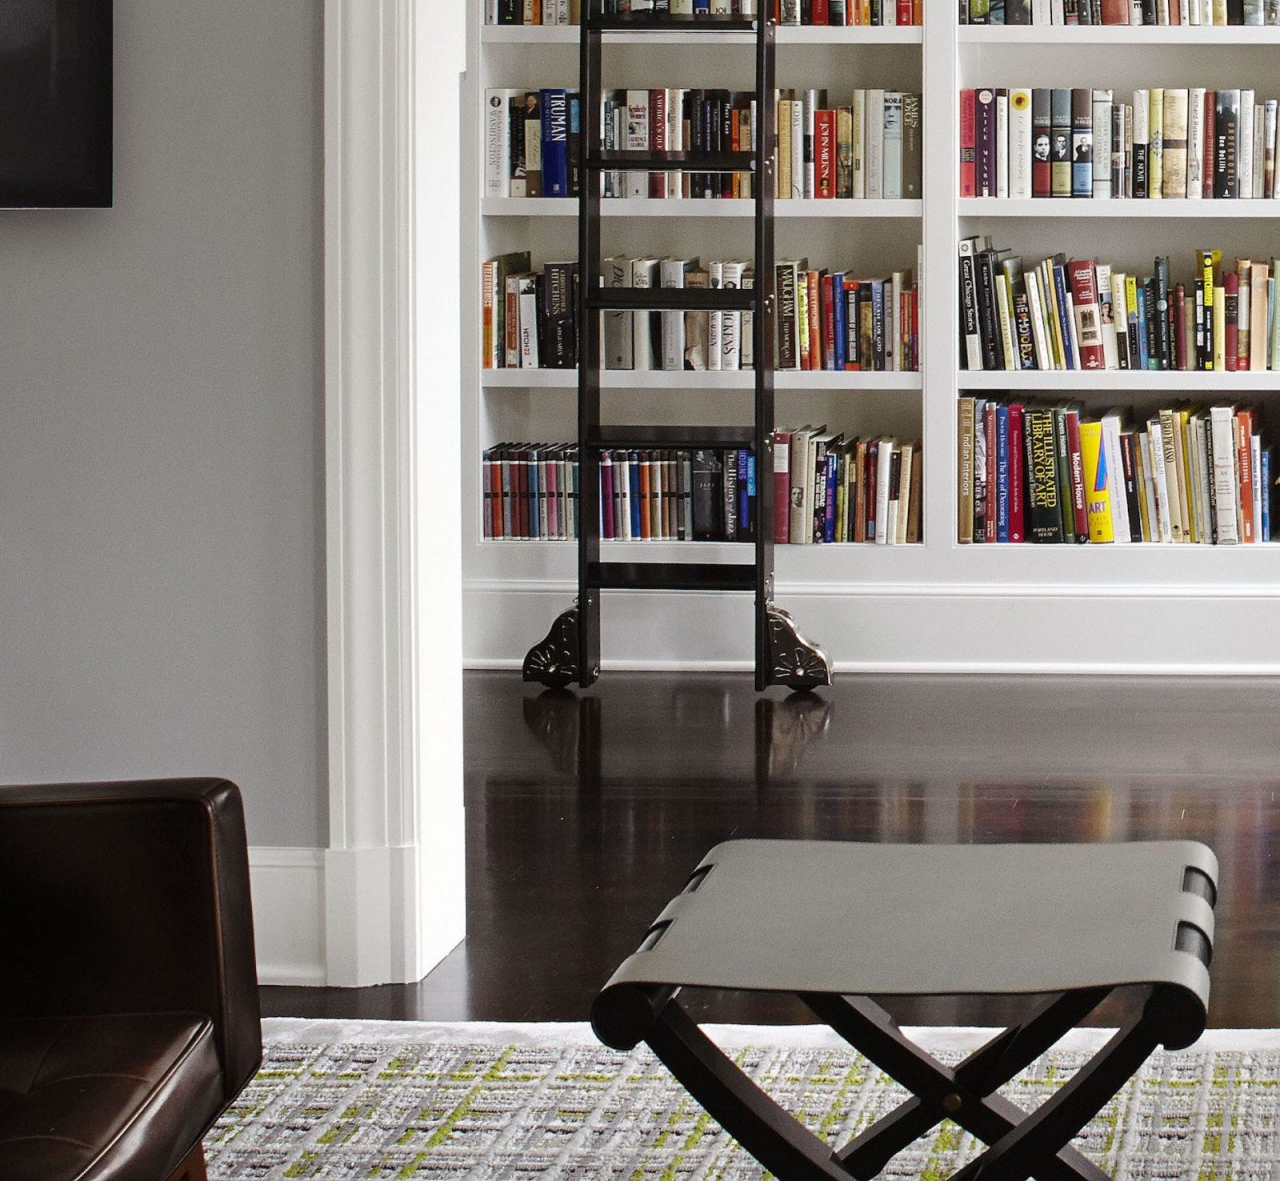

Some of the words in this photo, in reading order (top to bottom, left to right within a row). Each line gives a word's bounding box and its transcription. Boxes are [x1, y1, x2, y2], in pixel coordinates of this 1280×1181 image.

[550, 92, 566, 142] TRUMAN
[793, 110, 801, 127] DRY
[904, 97, 912, 126] JOYCE
[489, 109, 497, 167] WASHINGTON
[821, 123, 830, 144] JOHN
[821, 145, 830, 178] MILTON
[1227, 122, 1235, 186] UNDERWORLD
[962, 260, 971, 279] Great
[551, 268, 560, 315] HITCHENS
[782, 268, 793, 316] MAUGHAM
[964, 280, 973, 308] Chicago
[1204, 266, 1213, 306] WATCHMEN
[966, 308, 974, 331] Stories
[1042, 411, 1053, 429] THE
[1058, 415, 1067, 435] Green
[1161, 414, 1171, 436] PABLO
[962, 433, 971, 459] Indian
[1032, 413, 1044, 458] LIBRARY
[1059, 436, 1067, 458] Homes
[727, 454, 735, 468] The
[1026, 435, 1035, 471] Appreciation
[1163, 437, 1174, 463] PICASSO
[961, 461, 971, 496] Interiors
[997, 474, 1007, 484] Joy
[999, 460, 1007, 473] The
[1035, 460, 1045, 475] OF
[1043, 430, 1057, 508] ILLUSTRATED
[1072, 452, 1082, 481] Modern
[727, 469, 737, 503] History
[1028, 483, 1036, 507] Tradition
[1036, 479, 1047, 506] ART
[1073, 482, 1084, 509] House
[997, 493, 1007, 526] Decorating
[1088, 501, 1106, 513] ART
[727, 512, 736, 533] Jazz
